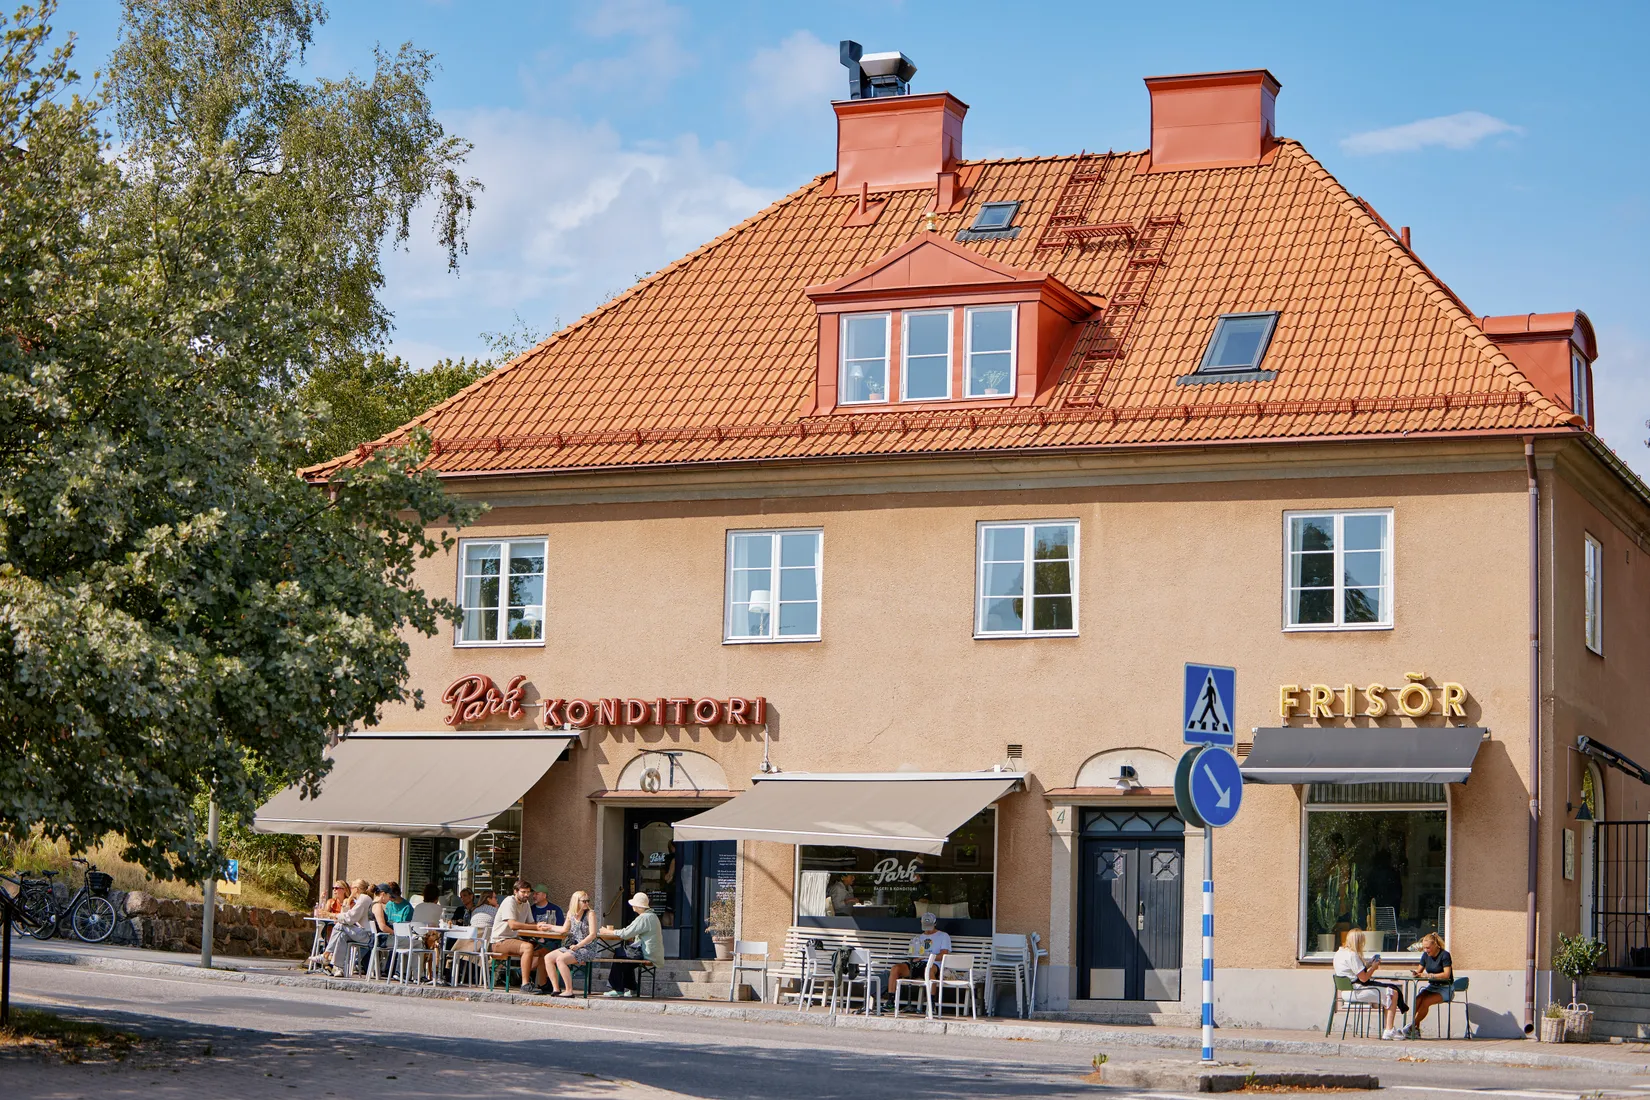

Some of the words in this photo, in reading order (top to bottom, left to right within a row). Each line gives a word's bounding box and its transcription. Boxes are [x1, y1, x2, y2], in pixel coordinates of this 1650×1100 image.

[442, 673, 526, 726] Park
[542, 696, 766, 727] KONDITORI
[1056, 808, 1066, 825] 4
[443, 849, 484, 876] Park
[873, 857, 918, 885] Park
